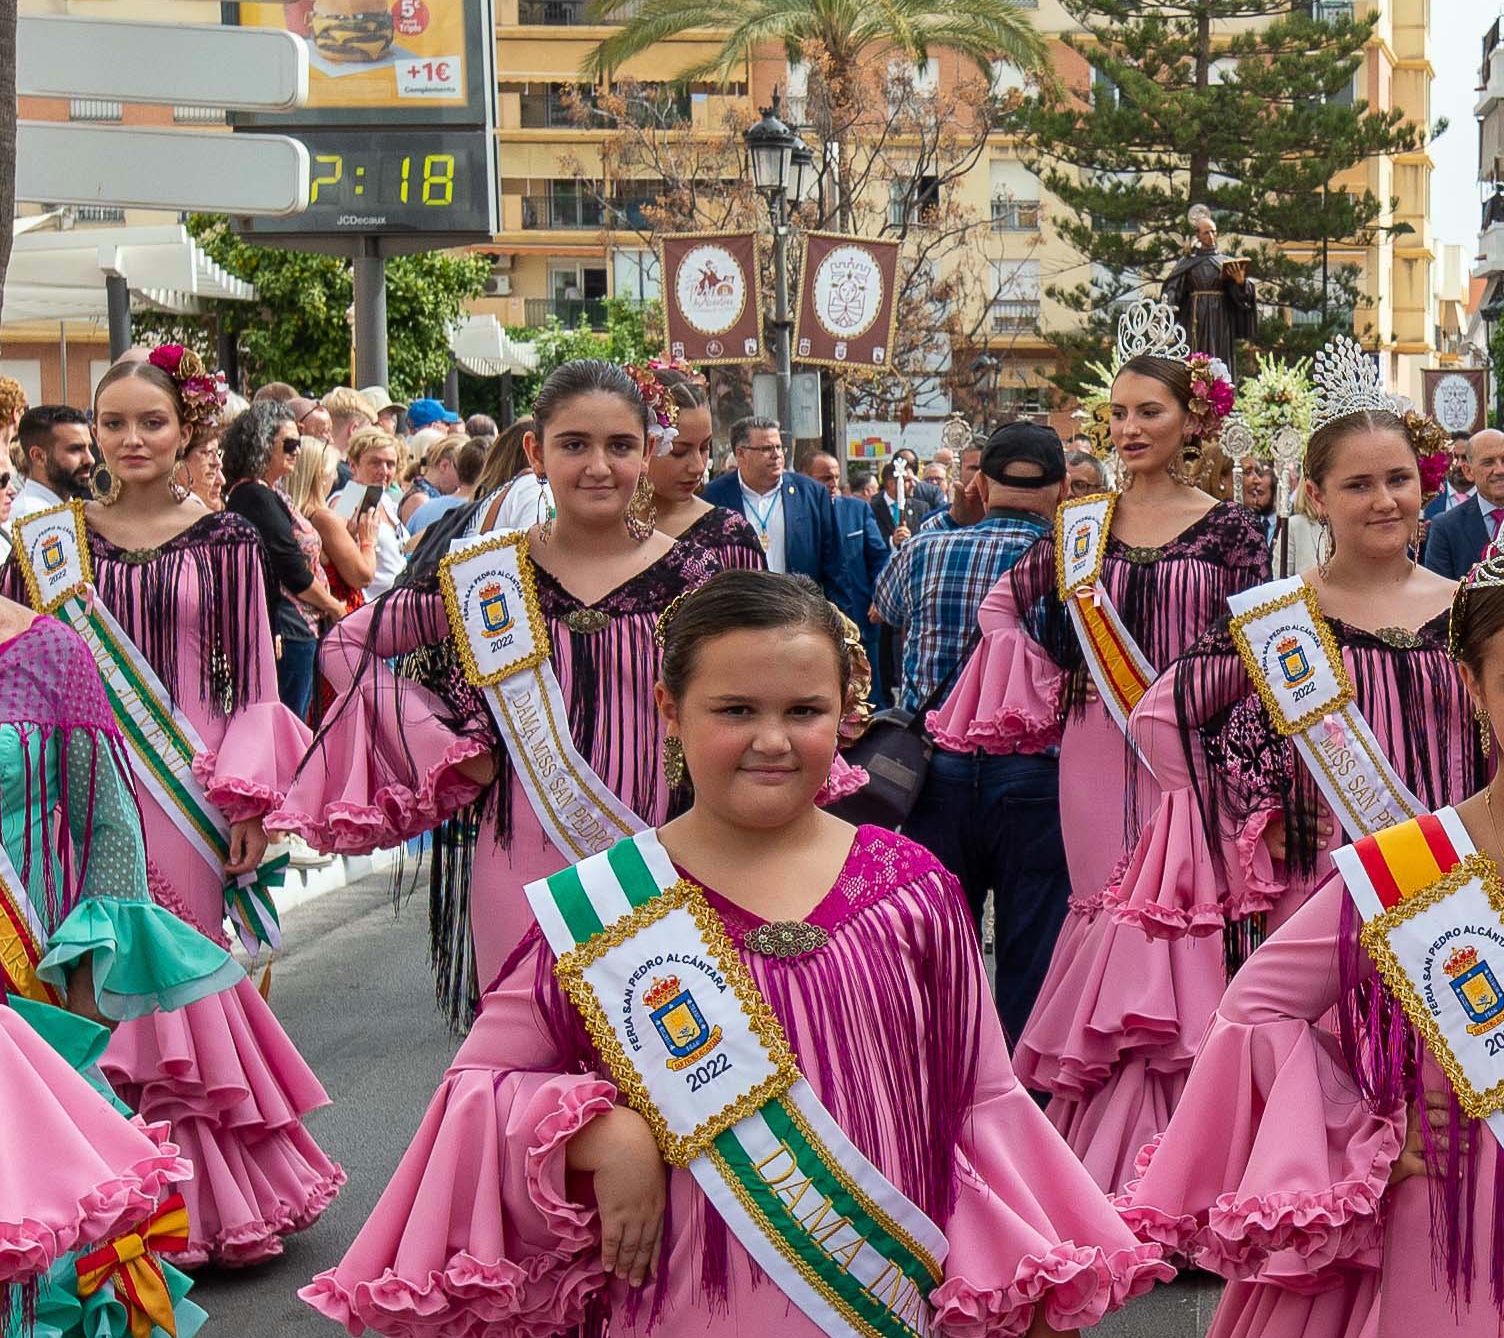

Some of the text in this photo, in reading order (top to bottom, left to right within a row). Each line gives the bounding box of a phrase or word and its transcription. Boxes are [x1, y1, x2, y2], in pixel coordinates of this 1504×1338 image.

[407, 62, 451, 82] +1€
[337, 215, 386, 227] JCDecaux
[490, 633, 515, 654] 2022
[1269, 625, 1291, 641] PEDRO
[1292, 681, 1317, 703] 2022
[116, 685, 192, 779] JUVENIL
[513, 691, 615, 852] DAMA MISS SAN PEDRO
[1319, 735, 1398, 832] MISS SAN PE
[1428, 927, 1462, 957] PEDRO
[628, 955, 664, 988] PEDRO
[666, 952, 728, 995] ALCÁNTARA
[1422, 957, 1434, 982] SAN
[622, 988, 634, 1014] SAN
[1423, 983, 1442, 1017] FERIA
[623, 1015, 643, 1052] FERIA
[685, 1052, 733, 1093] 2022
[749, 1138, 869, 1275] DAMA
